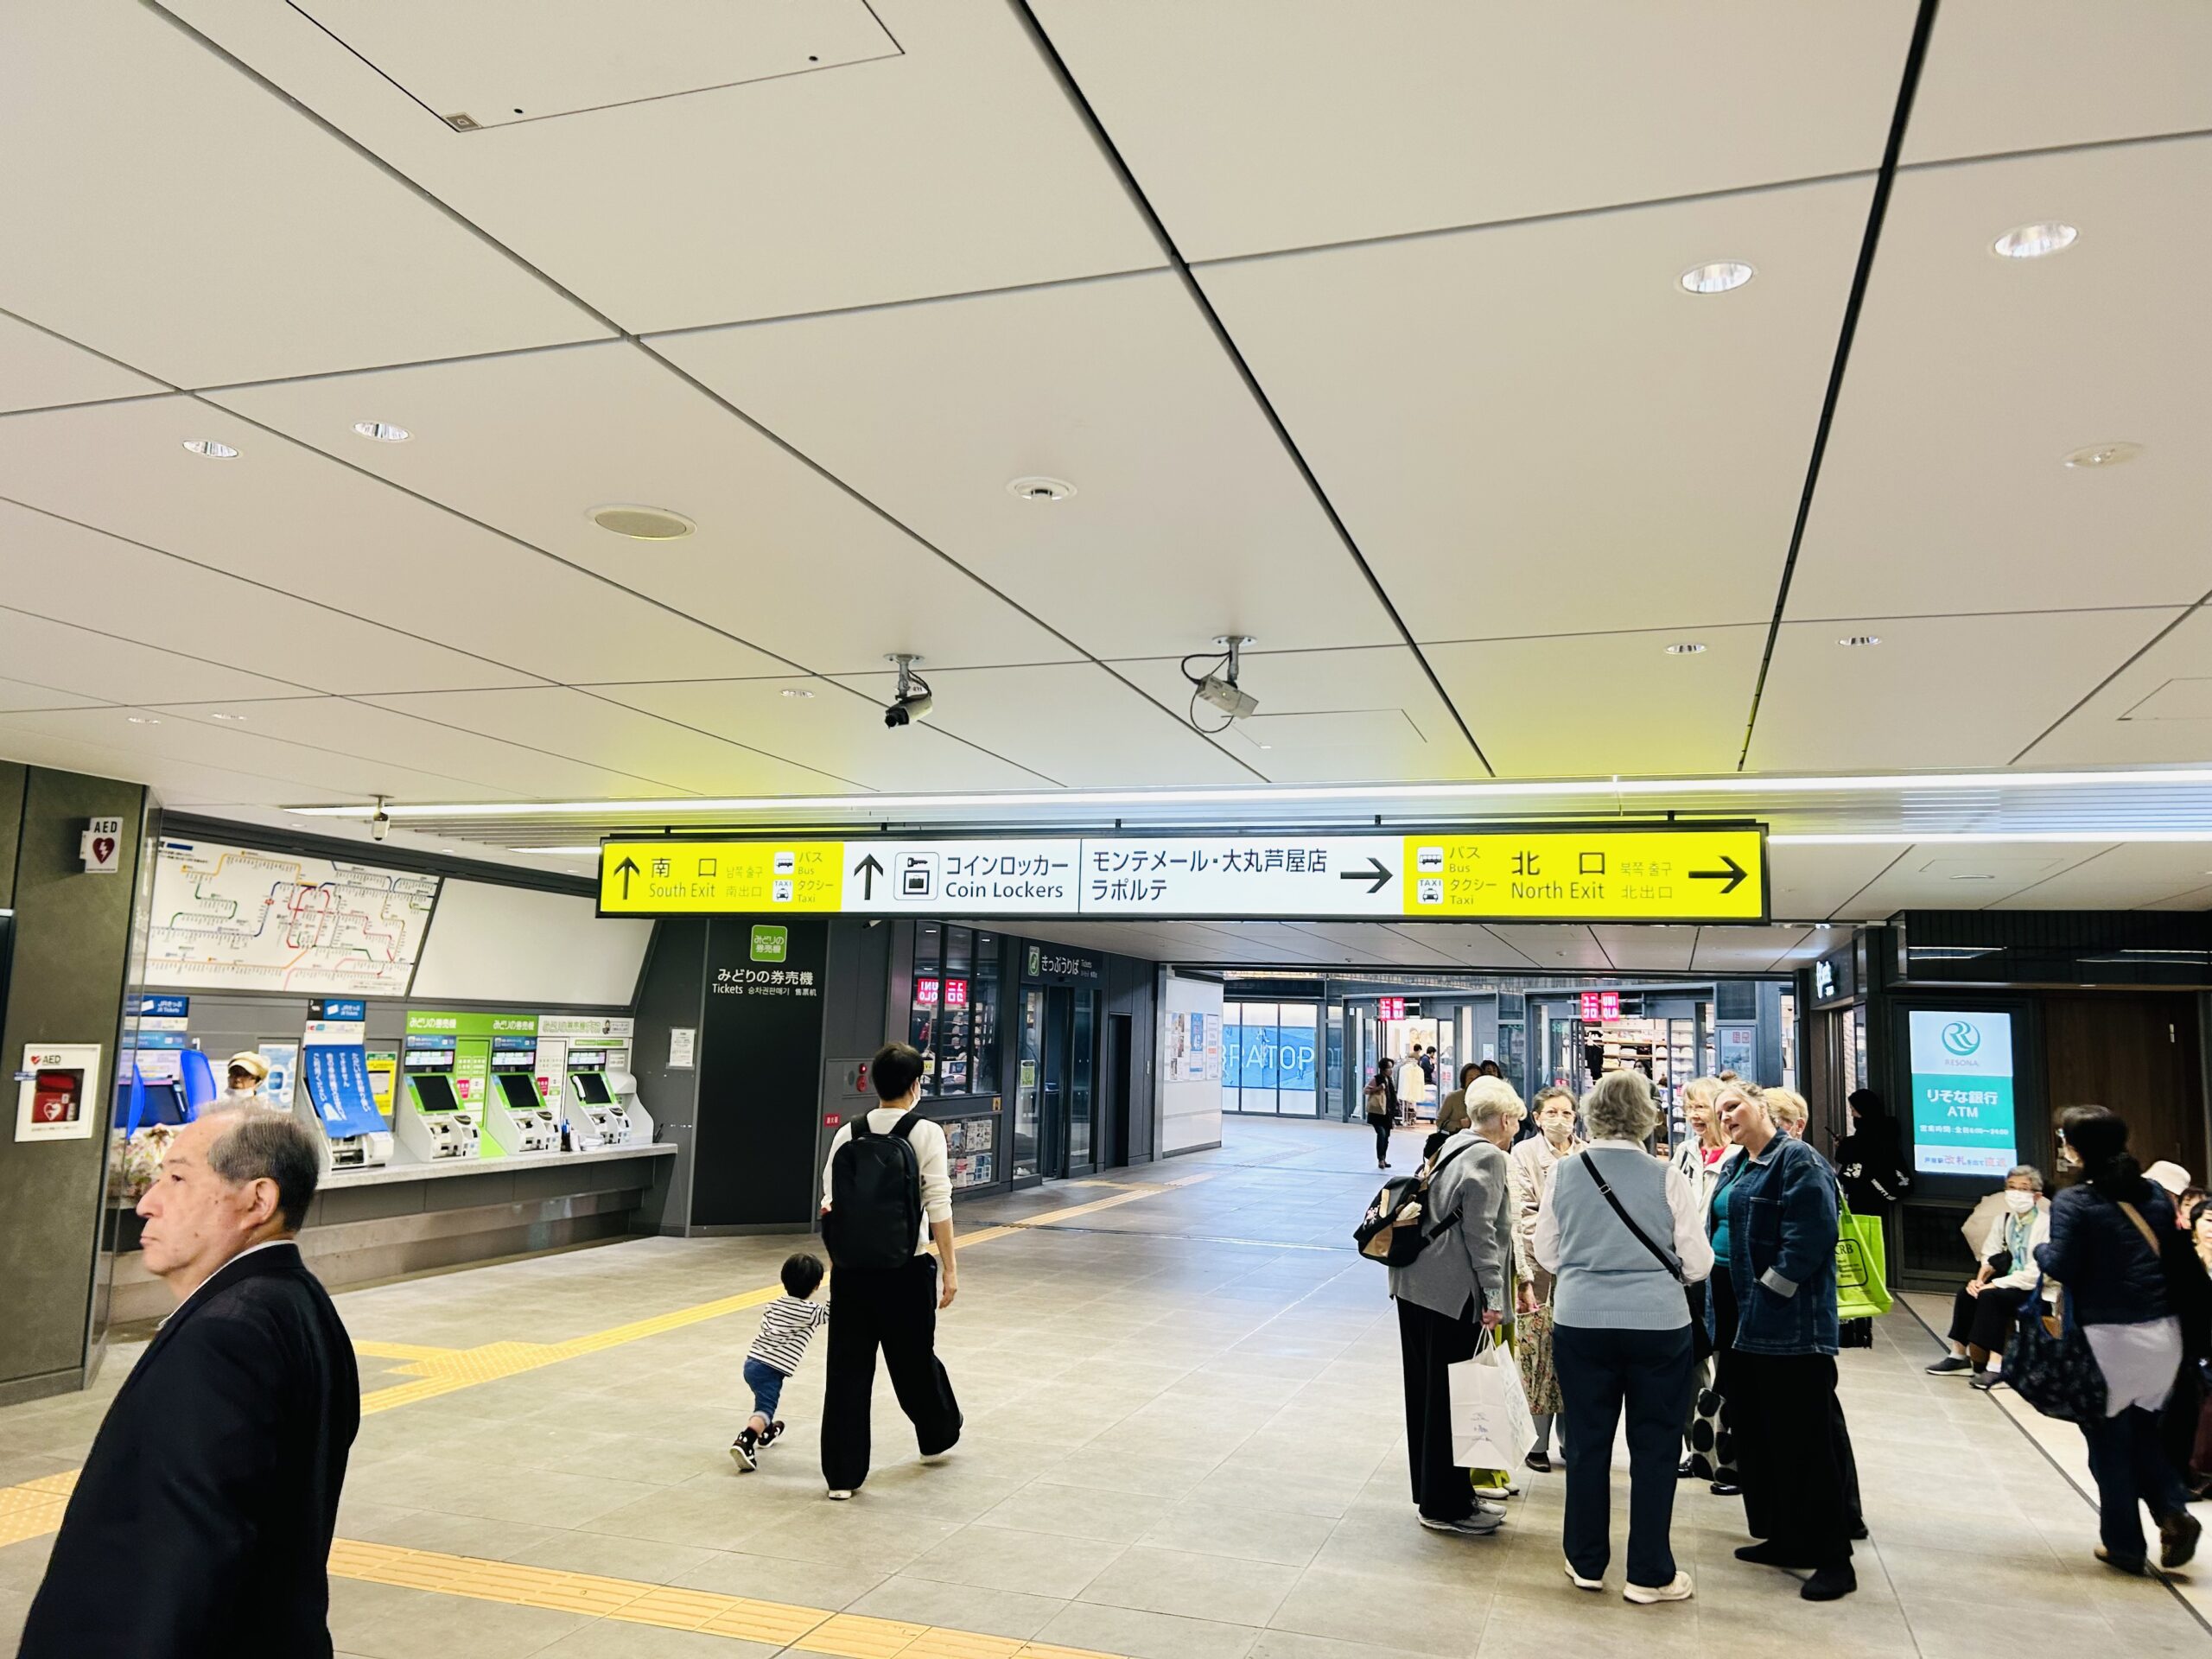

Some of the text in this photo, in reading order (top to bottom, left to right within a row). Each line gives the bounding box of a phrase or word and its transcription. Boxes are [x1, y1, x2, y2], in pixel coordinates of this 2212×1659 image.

[94, 821, 118, 833] AED
[798, 852, 823, 862] バス
[1449, 846, 1480, 859] バス
[946, 855, 1069, 876] コインロッカー
[1093, 849, 1327, 873] モンテメール・大丸芦屋店
[798, 867, 815, 875] Bus
[1449, 863, 1471, 873] Bus
[650, 882, 715, 898] South Exit
[797, 880, 834, 891] タクシー
[945, 880, 1064, 898] Coin Lockers
[1092, 878, 1167, 900] ラポルテ
[1449, 878, 1497, 892] タクシー
[1511, 881, 1605, 899] North Exit
[726, 886, 762, 898] 南出口
[1621, 885, 1673, 899] 北出口
[798, 894, 816, 903] Taxi
[1451, 894, 1474, 905] Taxi
[753, 935, 785, 945] みどりの
[1041, 955, 1079, 976] きっぷうりば
[717, 969, 813, 986] みどりの券売機
[712, 983, 743, 995] Tickets
[42, 1055, 61, 1064] AED
[1927, 1089, 1999, 1105] りそな銀行
[1947, 1106, 1979, 1118] ATM
